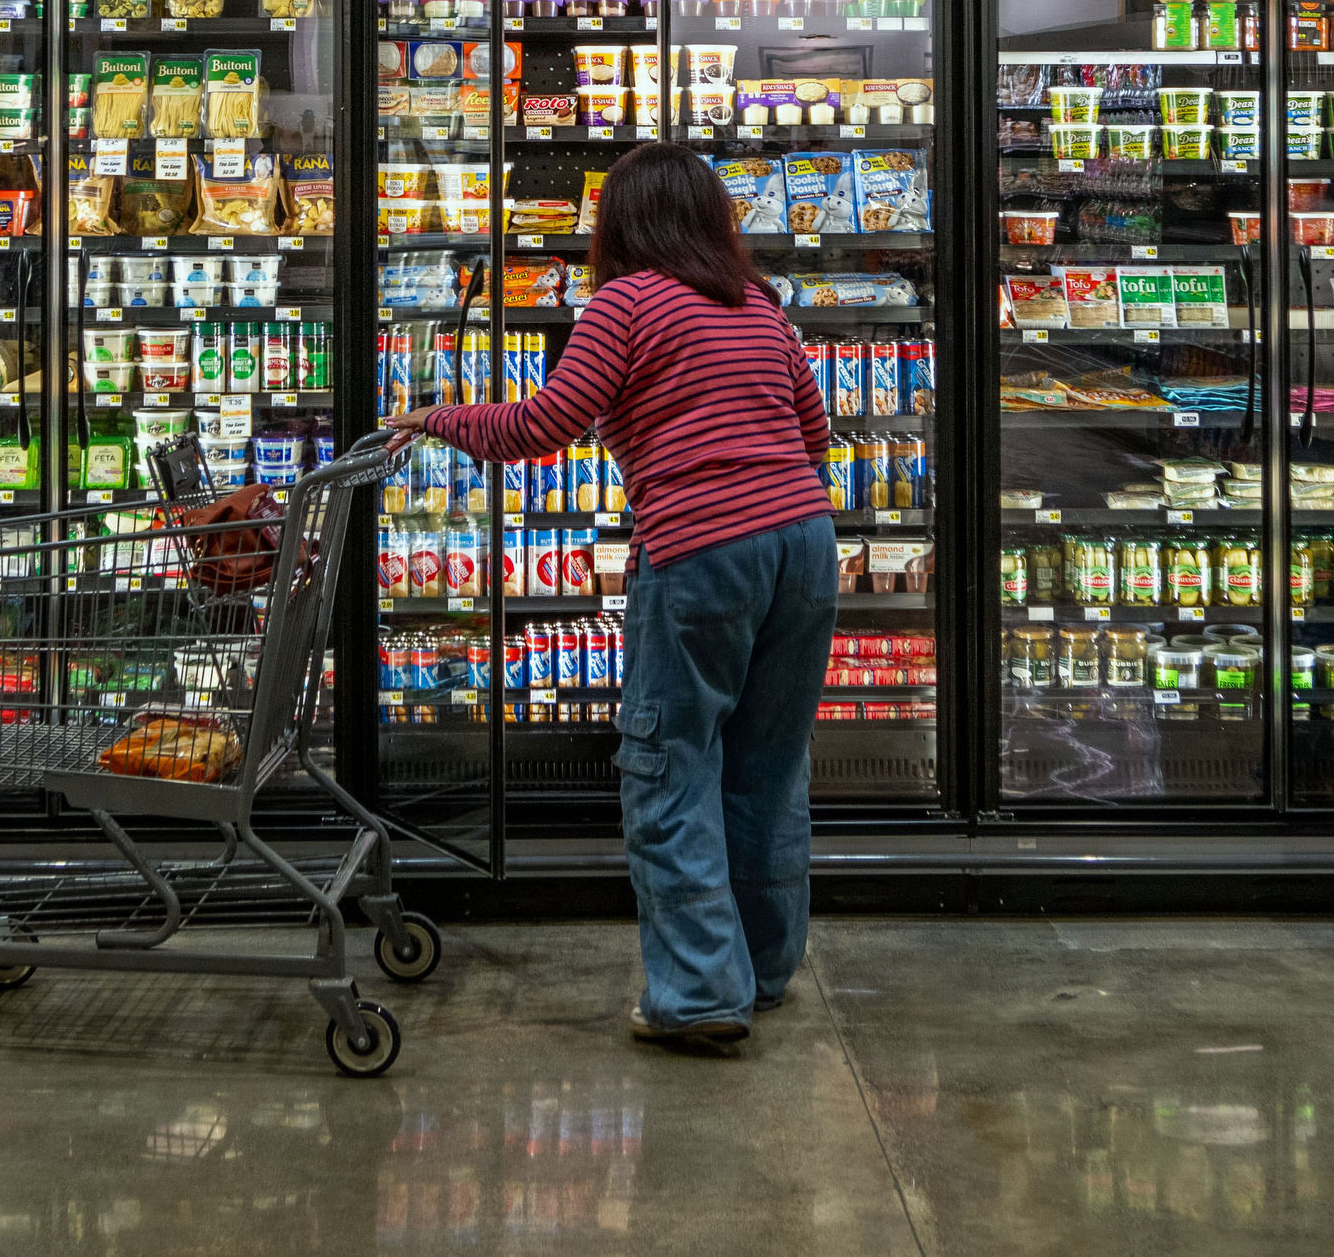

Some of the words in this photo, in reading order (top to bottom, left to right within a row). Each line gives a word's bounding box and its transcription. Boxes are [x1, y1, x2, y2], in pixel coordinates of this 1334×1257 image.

[101, 61, 143, 76] Buitoni
[211, 59, 252, 72] Buitoni
[158, 66, 197, 77] Buitoni
[294, 158, 329, 170] RANA
[787, 175, 825, 185] Cookie
[790, 183, 825, 193] Dough
[1122, 280, 1156, 293] tofu
[1174, 279, 1208, 293] tofu
[0, 455, 20, 463] FETA
[596, 546, 629, 554] almond
[1170, 575, 1201, 585] claussen
